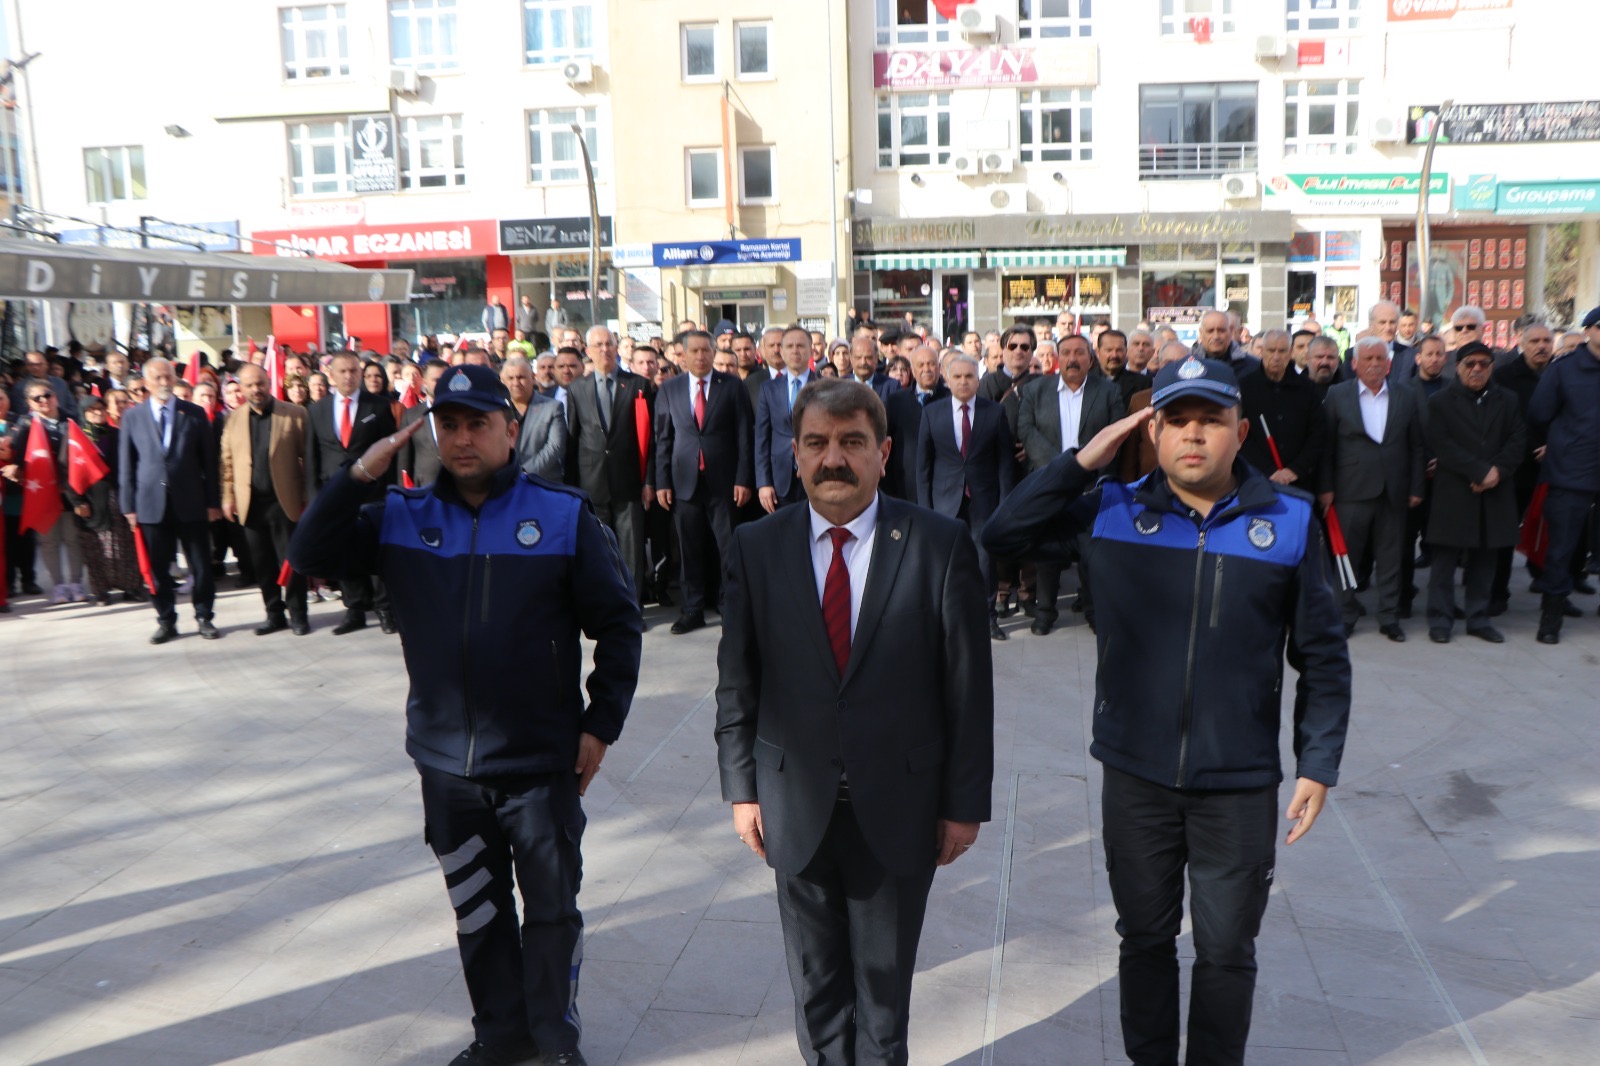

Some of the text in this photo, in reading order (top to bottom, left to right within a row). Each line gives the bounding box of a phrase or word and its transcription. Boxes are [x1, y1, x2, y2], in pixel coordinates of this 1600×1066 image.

[884, 48, 1027, 79] DAYAN
[1506, 186, 1597, 207] Groupama
[353, 226, 472, 255] ECZANESİ
[504, 224, 557, 246] DENİZ
[911, 217, 976, 246] BÖREKÇİSİ
[663, 247, 699, 261] Allianz
